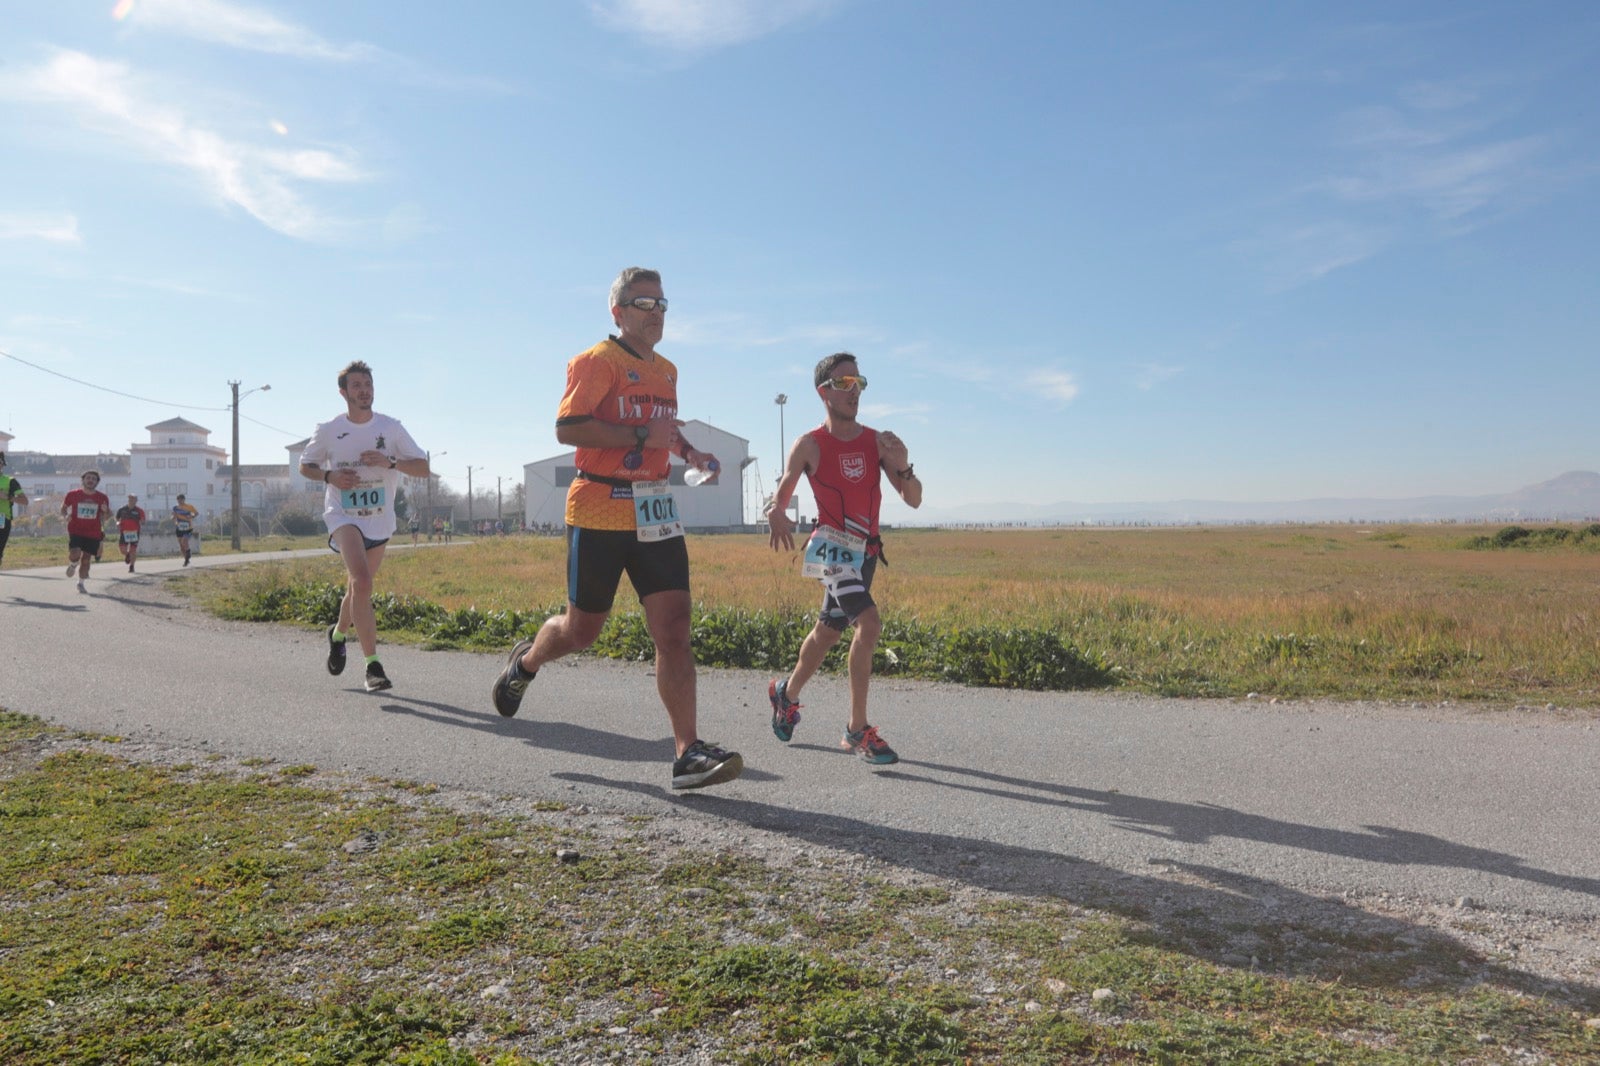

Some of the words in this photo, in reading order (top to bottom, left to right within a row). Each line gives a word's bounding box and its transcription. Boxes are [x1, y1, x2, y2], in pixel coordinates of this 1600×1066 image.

[842, 458, 863, 467] CLUB
[349, 490, 379, 506] 110
[815, 542, 854, 563] 419
